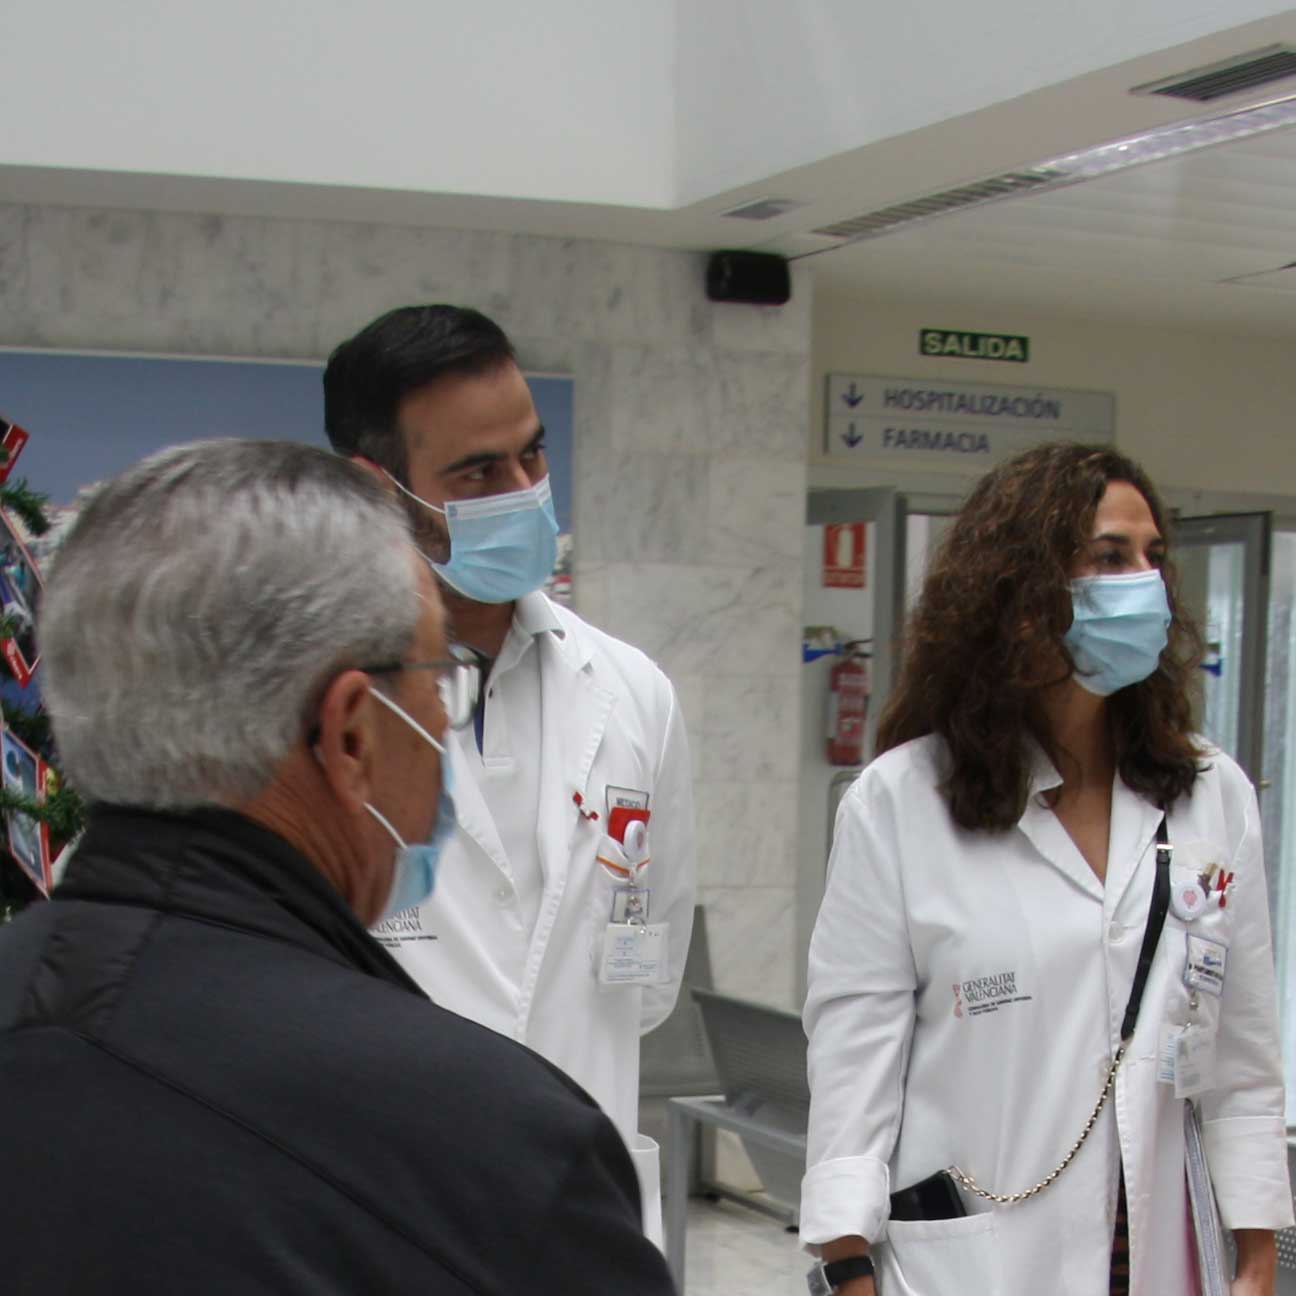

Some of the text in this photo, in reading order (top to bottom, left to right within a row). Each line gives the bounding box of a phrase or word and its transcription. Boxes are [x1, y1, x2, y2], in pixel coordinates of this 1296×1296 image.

[925, 333, 1024, 359] SALIDA
[883, 388, 1061, 419] HOSPITALIZACIÓN
[883, 428, 991, 453] FARMACIA
